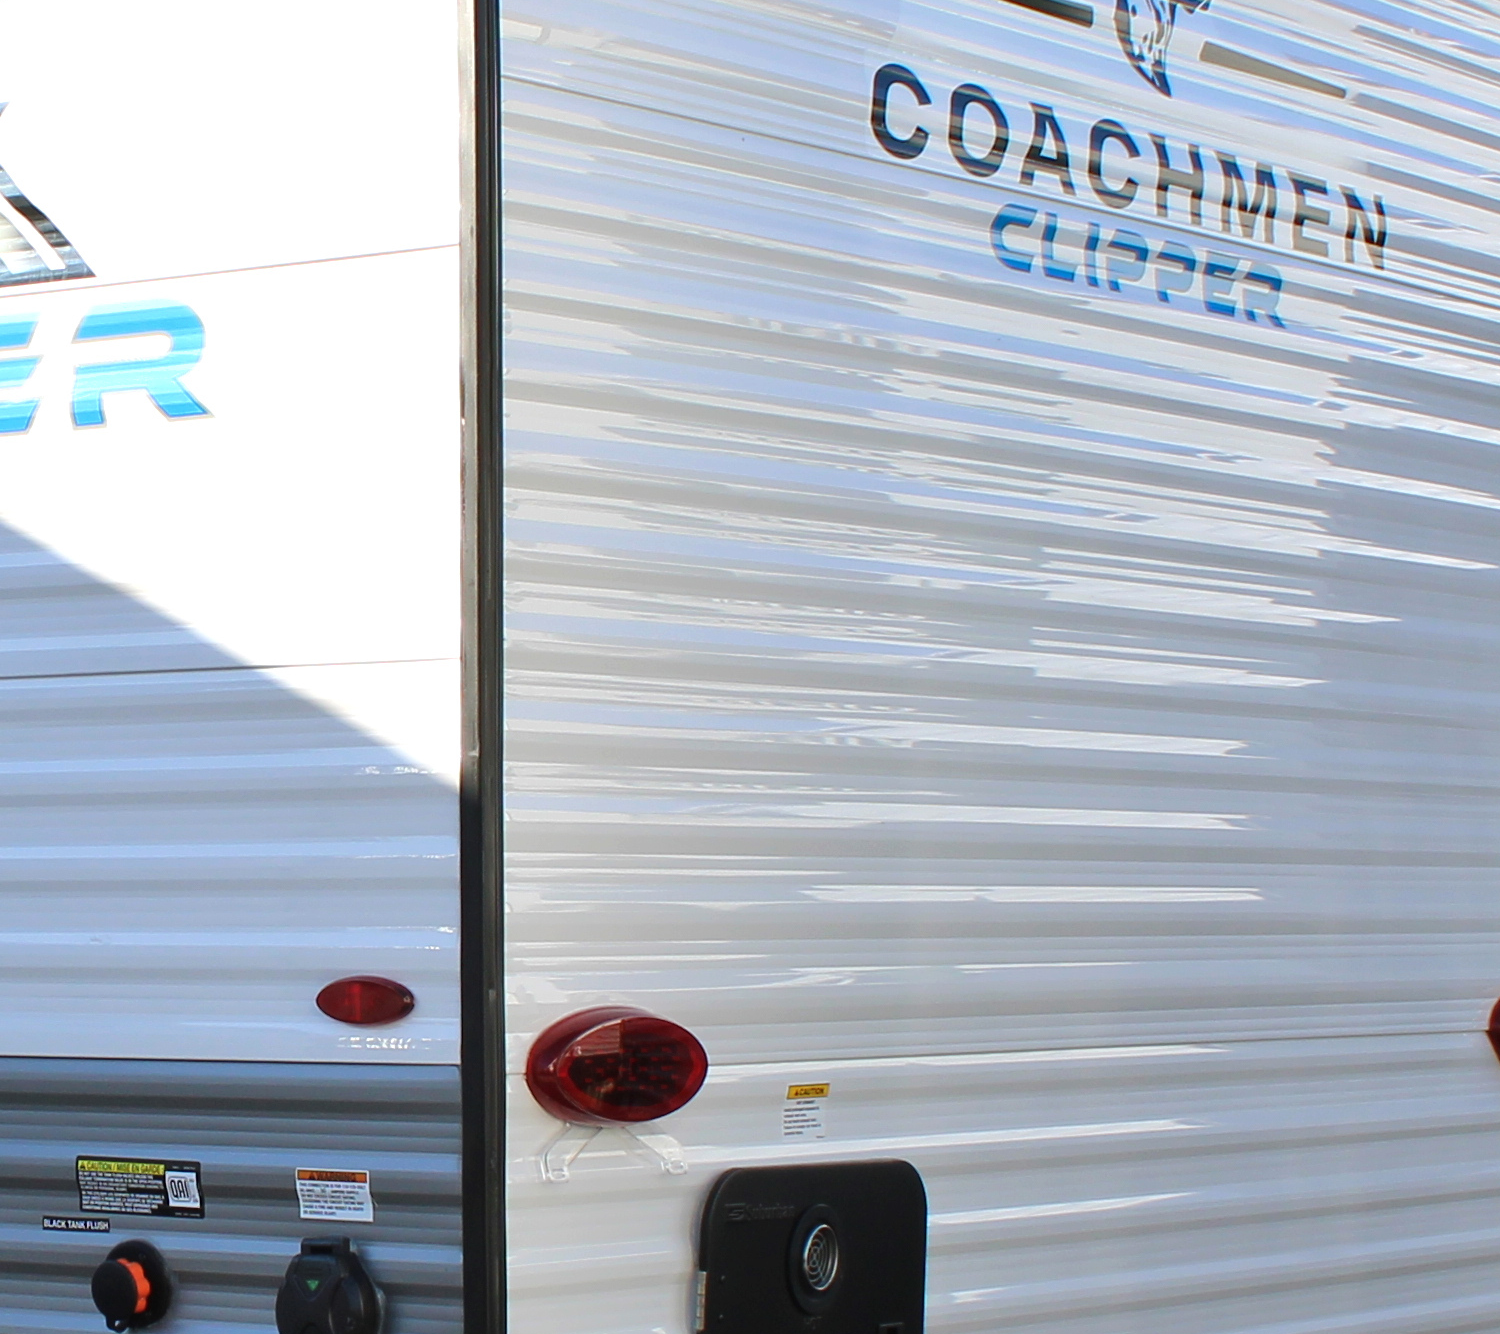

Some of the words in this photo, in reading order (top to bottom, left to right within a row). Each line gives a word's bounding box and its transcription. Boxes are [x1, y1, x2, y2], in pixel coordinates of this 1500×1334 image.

[869, 63, 1388, 270] COACHMEN
[990, 202, 1285, 328] CLIPPER
[43, 1218, 67, 1229] BLACK
[67, 1220, 86, 1230] TANK
[86, 1220, 109, 1231] FLUSH
